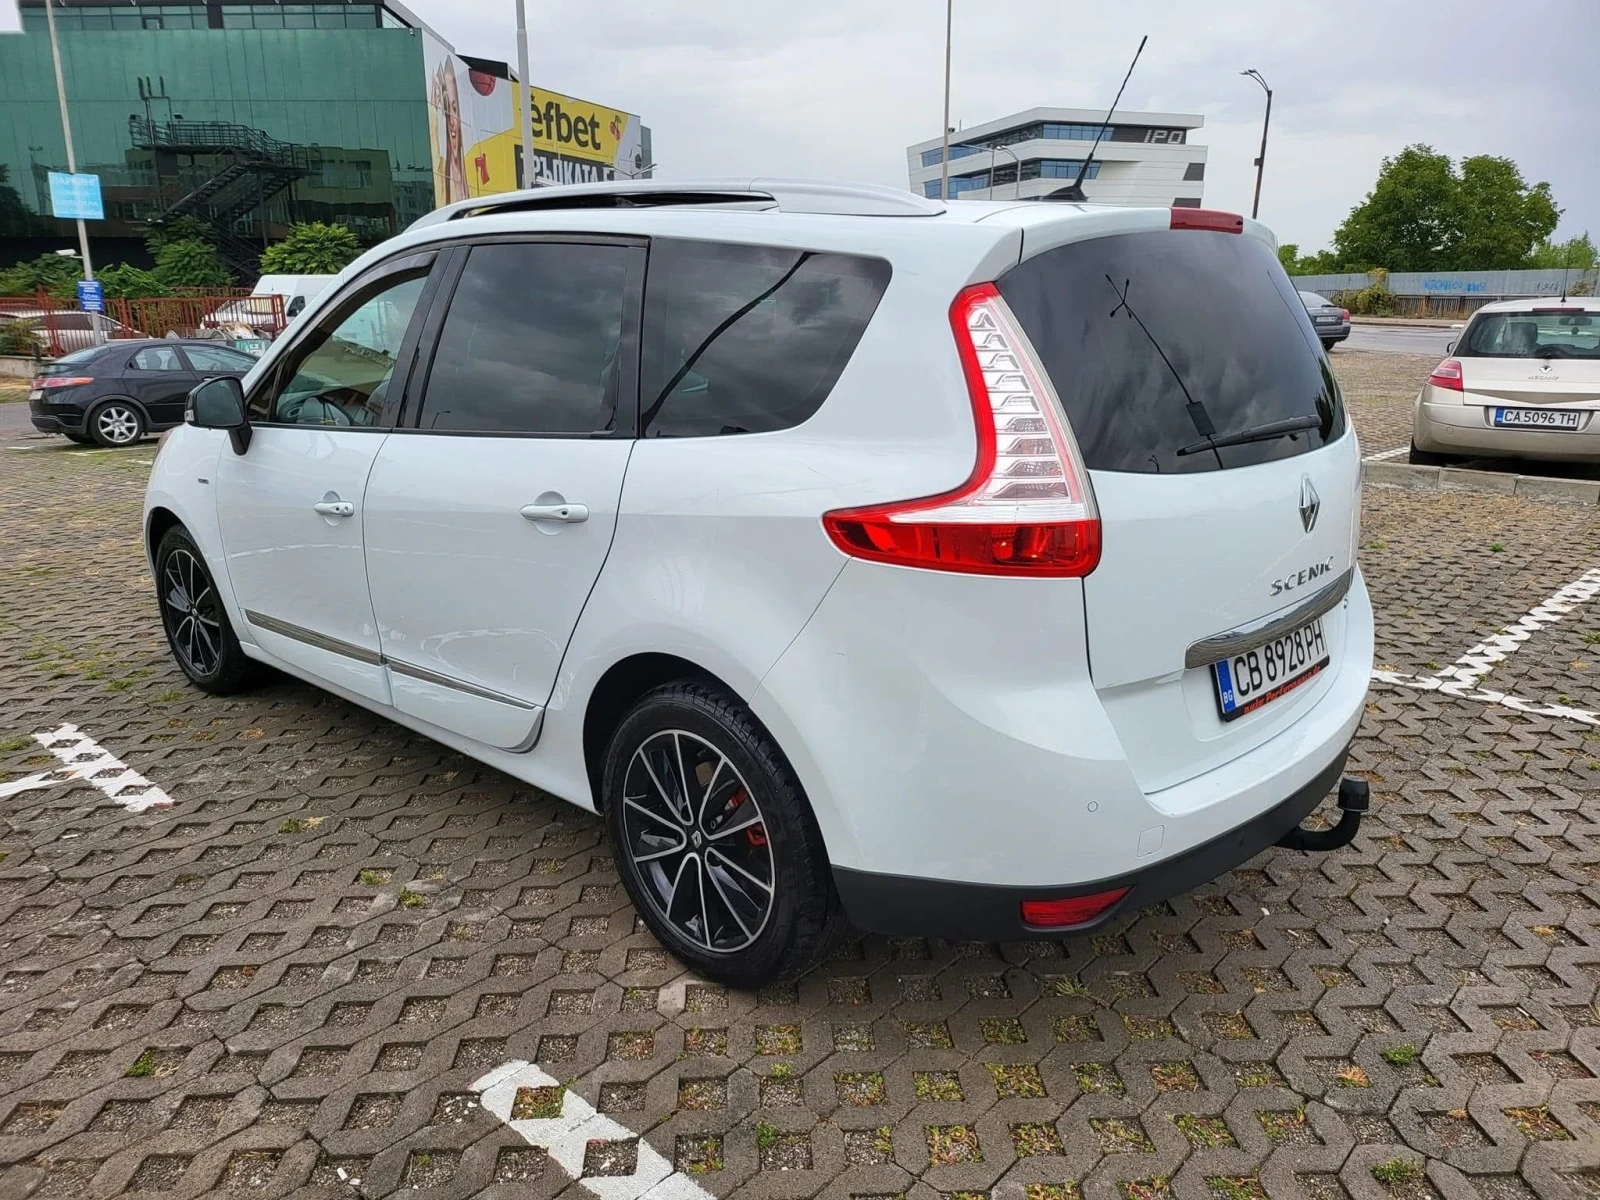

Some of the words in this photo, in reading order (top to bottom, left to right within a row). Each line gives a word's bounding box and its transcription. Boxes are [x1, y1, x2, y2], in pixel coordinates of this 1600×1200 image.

[530, 101, 602, 151] efbet
[1143, 129, 1184, 144] IPO
[520, 152, 600, 185] РЪПКАТА
[1504, 410, 1521, 422] CA
[1523, 411, 1556, 424] 5096
[1559, 413, 1577, 425] TH
[1269, 556, 1334, 597] SCENIC
[1233, 650, 1263, 697] CB
[1264, 631, 1305, 682] 8928
[1304, 619, 1325, 661] PH
[1223, 689, 1234, 704] BG
